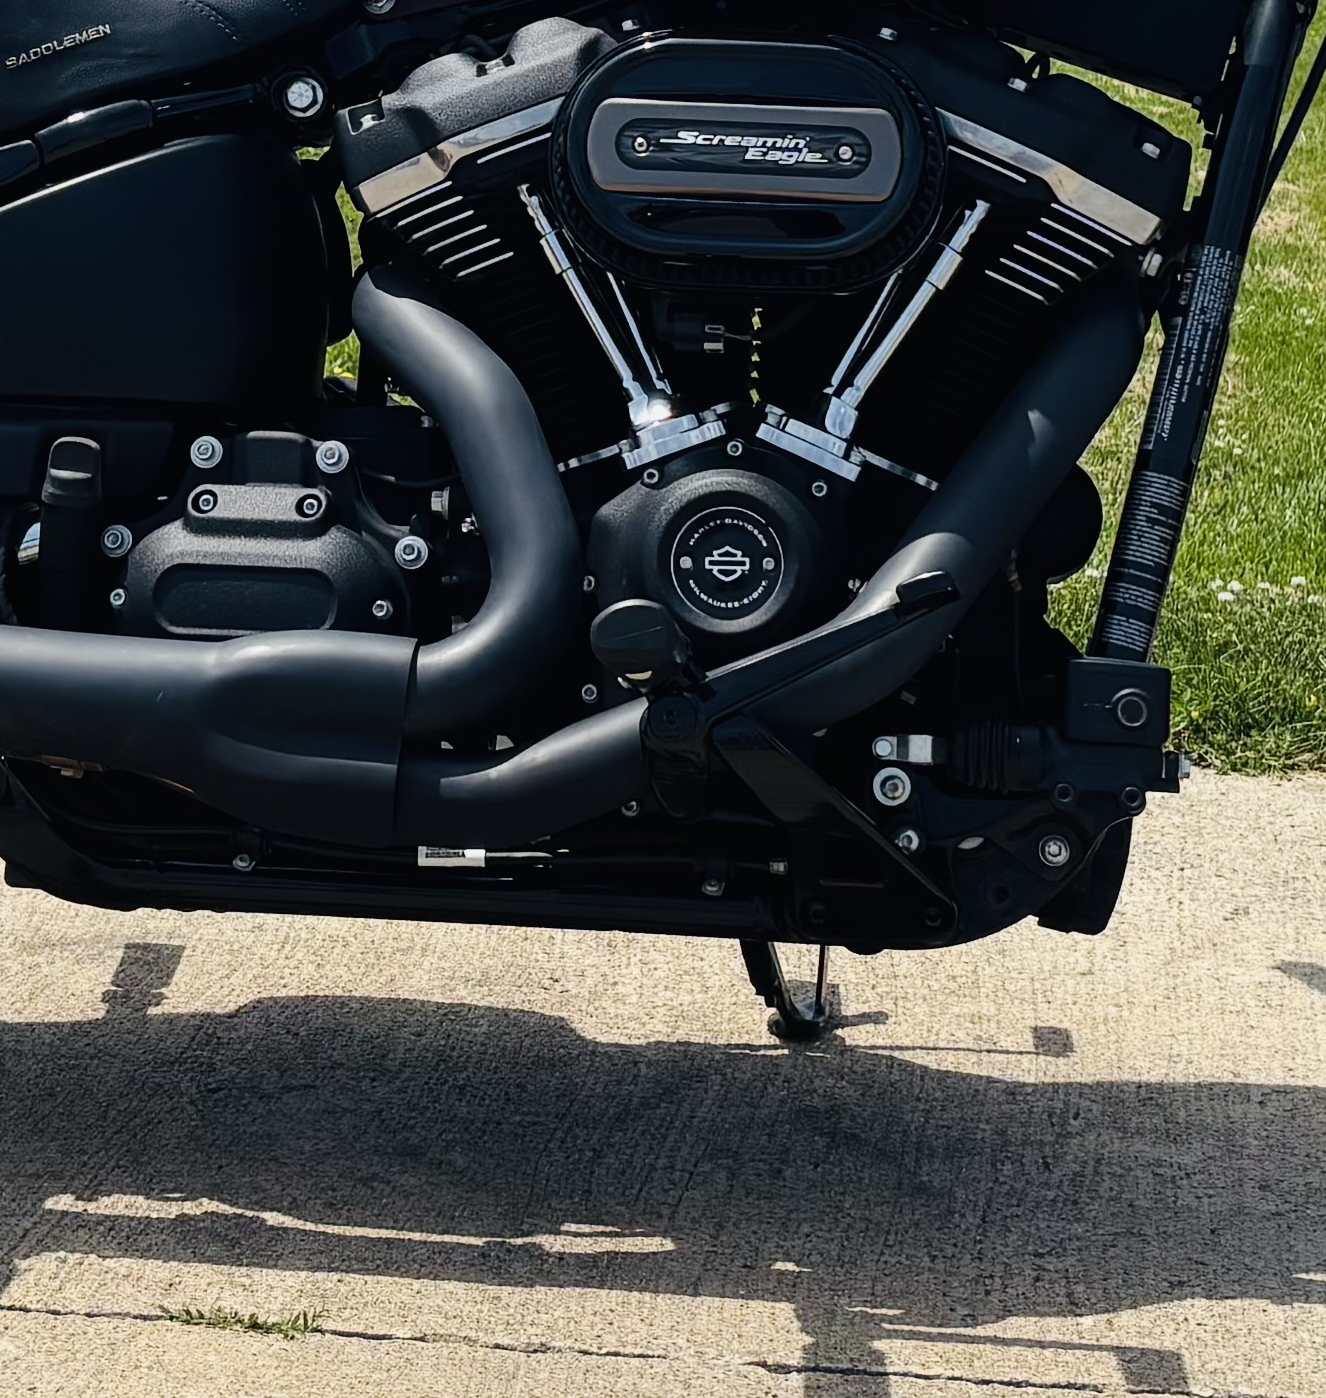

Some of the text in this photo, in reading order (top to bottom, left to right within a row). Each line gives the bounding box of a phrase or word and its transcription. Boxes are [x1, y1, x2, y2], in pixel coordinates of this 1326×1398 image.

[5, 23, 111, 69] SADDLEMEN
[659, 130, 810, 149] Screamin'
[744, 147, 829, 165] Eagle
